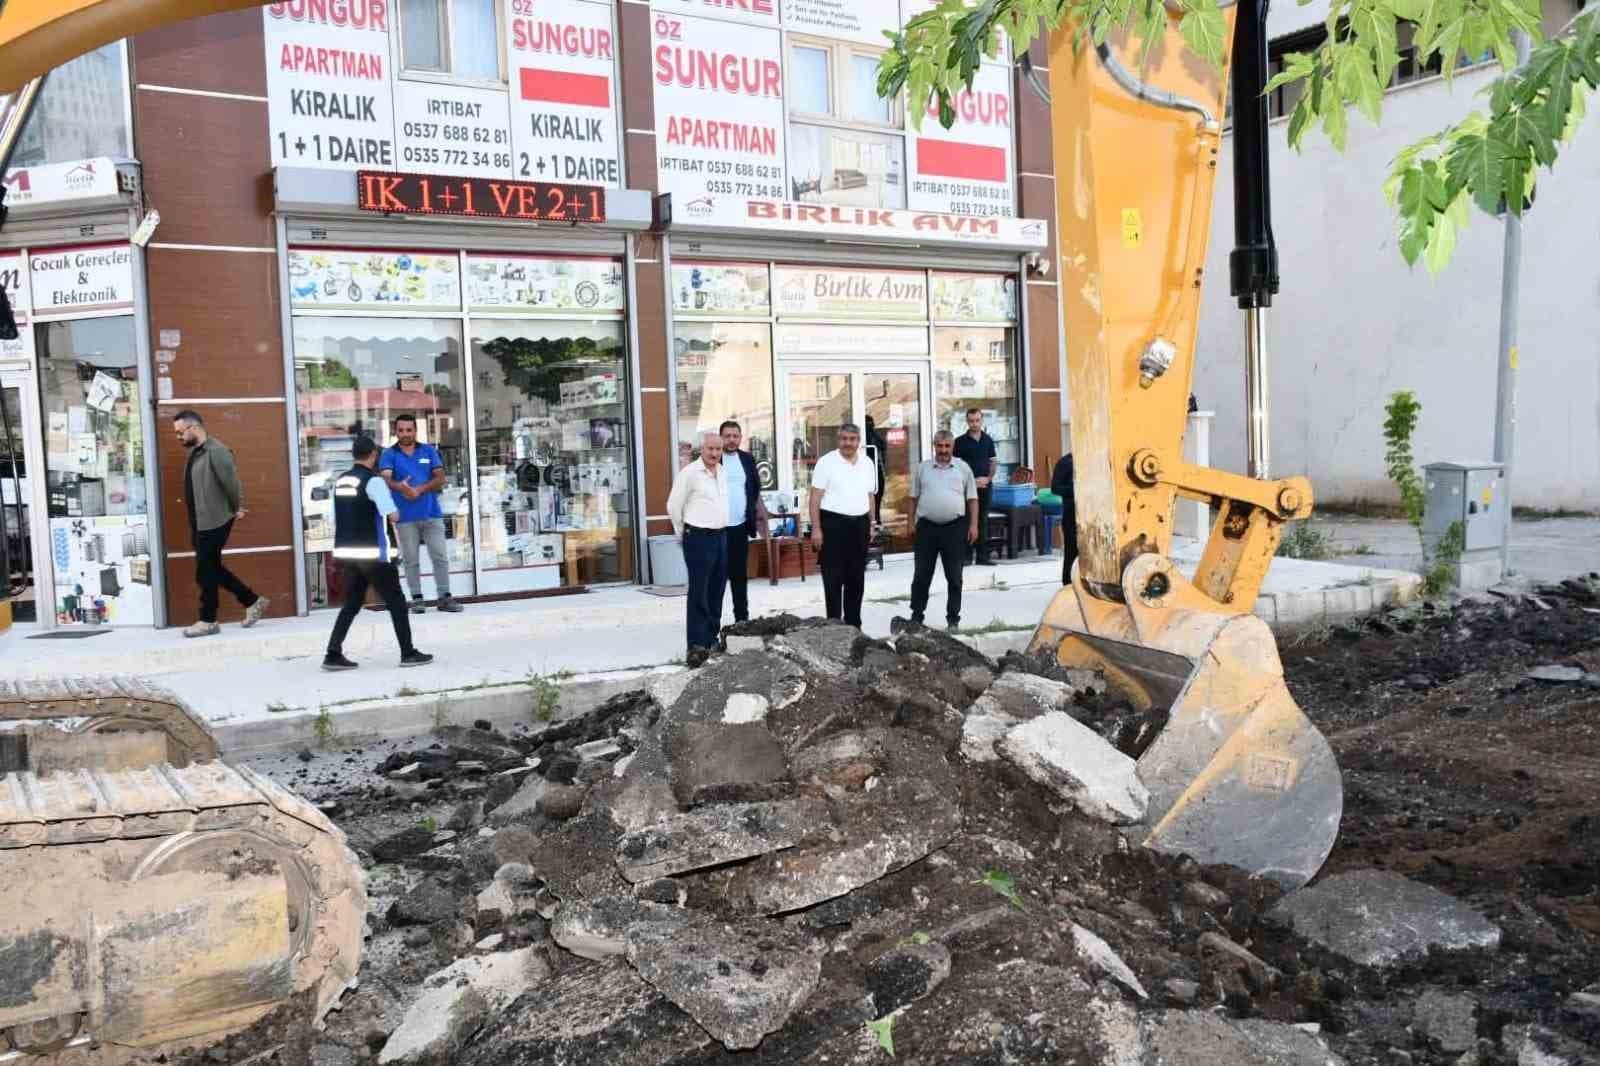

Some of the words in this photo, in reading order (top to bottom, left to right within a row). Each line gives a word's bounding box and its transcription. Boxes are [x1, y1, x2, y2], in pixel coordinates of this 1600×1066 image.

[512, 18, 613, 60] SUNGUR
[655, 14, 681, 41] ÖZ
[280, 43, 383, 81] APARTMAN
[655, 45, 782, 99] SUNGUR
[403, 122, 438, 139] 0537
[443, 125, 469, 141] 688
[473, 127, 490, 143] 62
[494, 129, 508, 144] 81
[666, 115, 776, 156] APARTMAN
[403, 147, 439, 163] 0535
[443, 149, 468, 165] 772
[472, 151, 489, 167] 34
[494, 153, 510, 168] 86
[707, 160, 732, 175] 0537
[735, 163, 754, 177] 688
[756, 166, 769, 179] 62
[488, 183, 539, 217] VE
[706, 180, 732, 194] 0535
[735, 183, 753, 197] 772
[755, 184, 768, 198] 34
[912, 214, 998, 234] AVM
[77, 271, 89, 285] &
[877, 276, 924, 300] Avm
[53, 287, 118, 305] Elektronik
